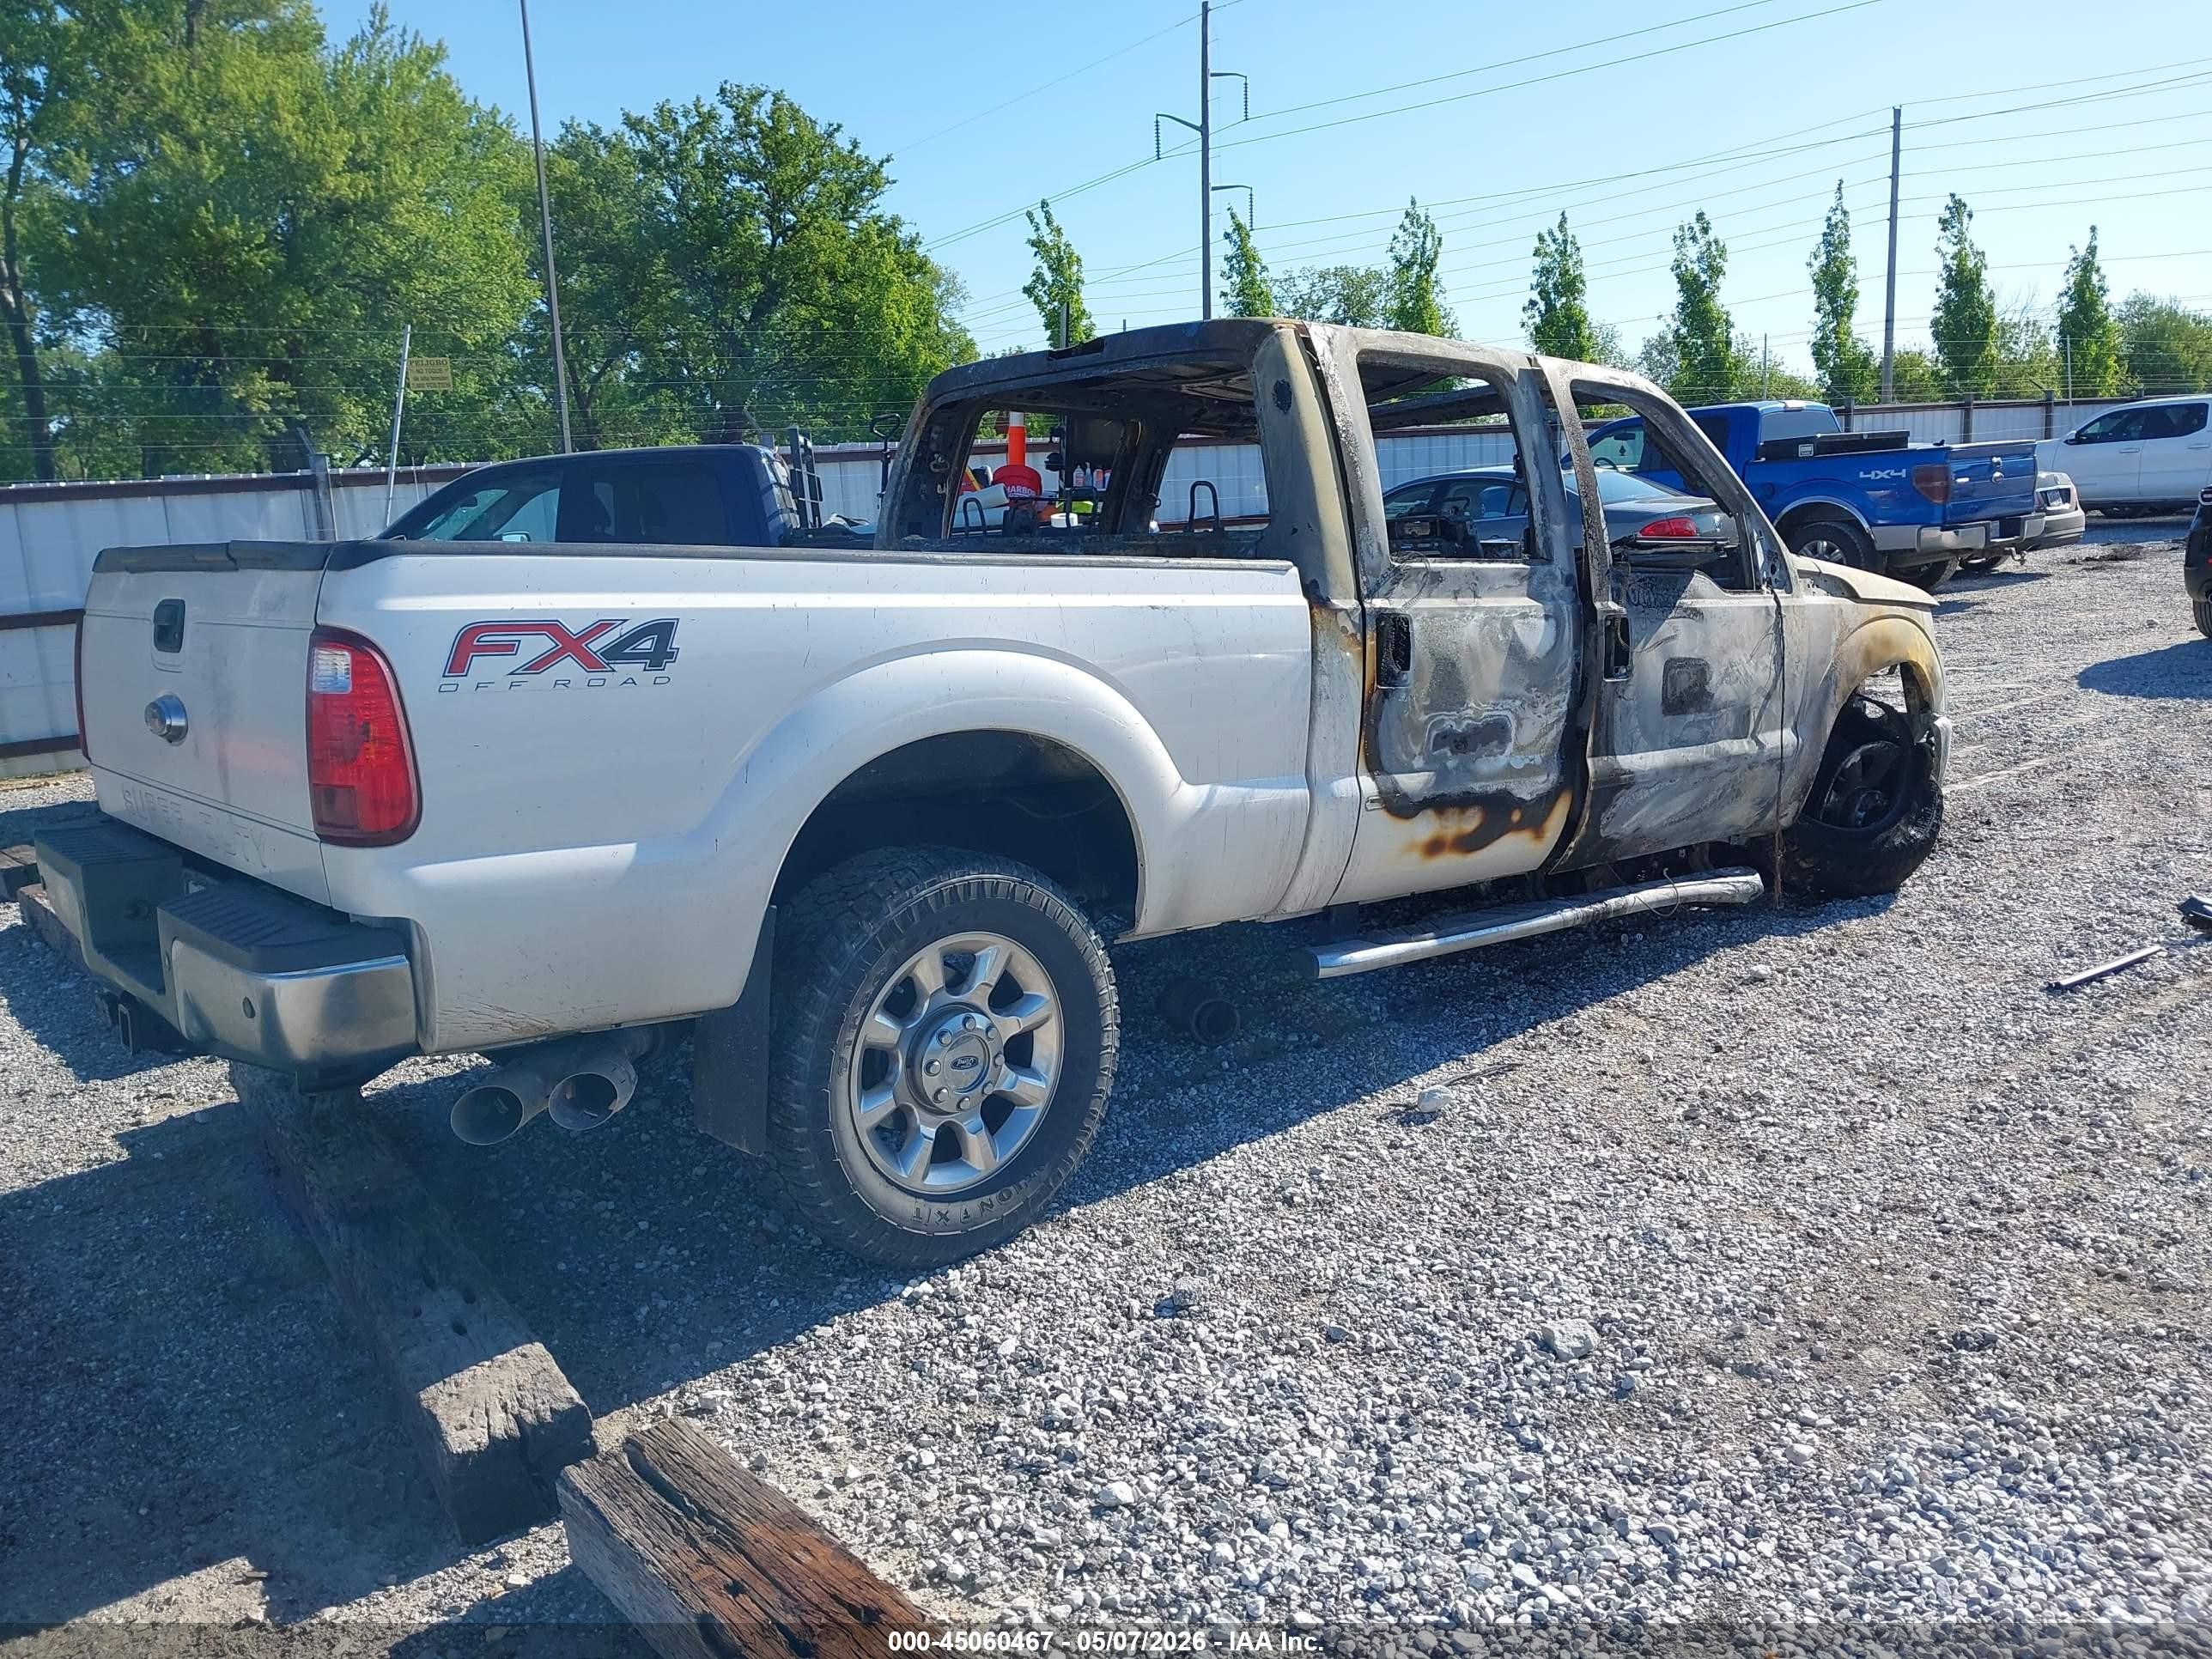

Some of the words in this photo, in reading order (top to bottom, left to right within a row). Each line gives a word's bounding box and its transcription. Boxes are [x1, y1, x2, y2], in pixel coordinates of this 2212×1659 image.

[1859, 469, 1906, 480] 4X4
[442, 618, 679, 678] FX4
[438, 680, 529, 693] OFF
[552, 676, 672, 689] ROAD
